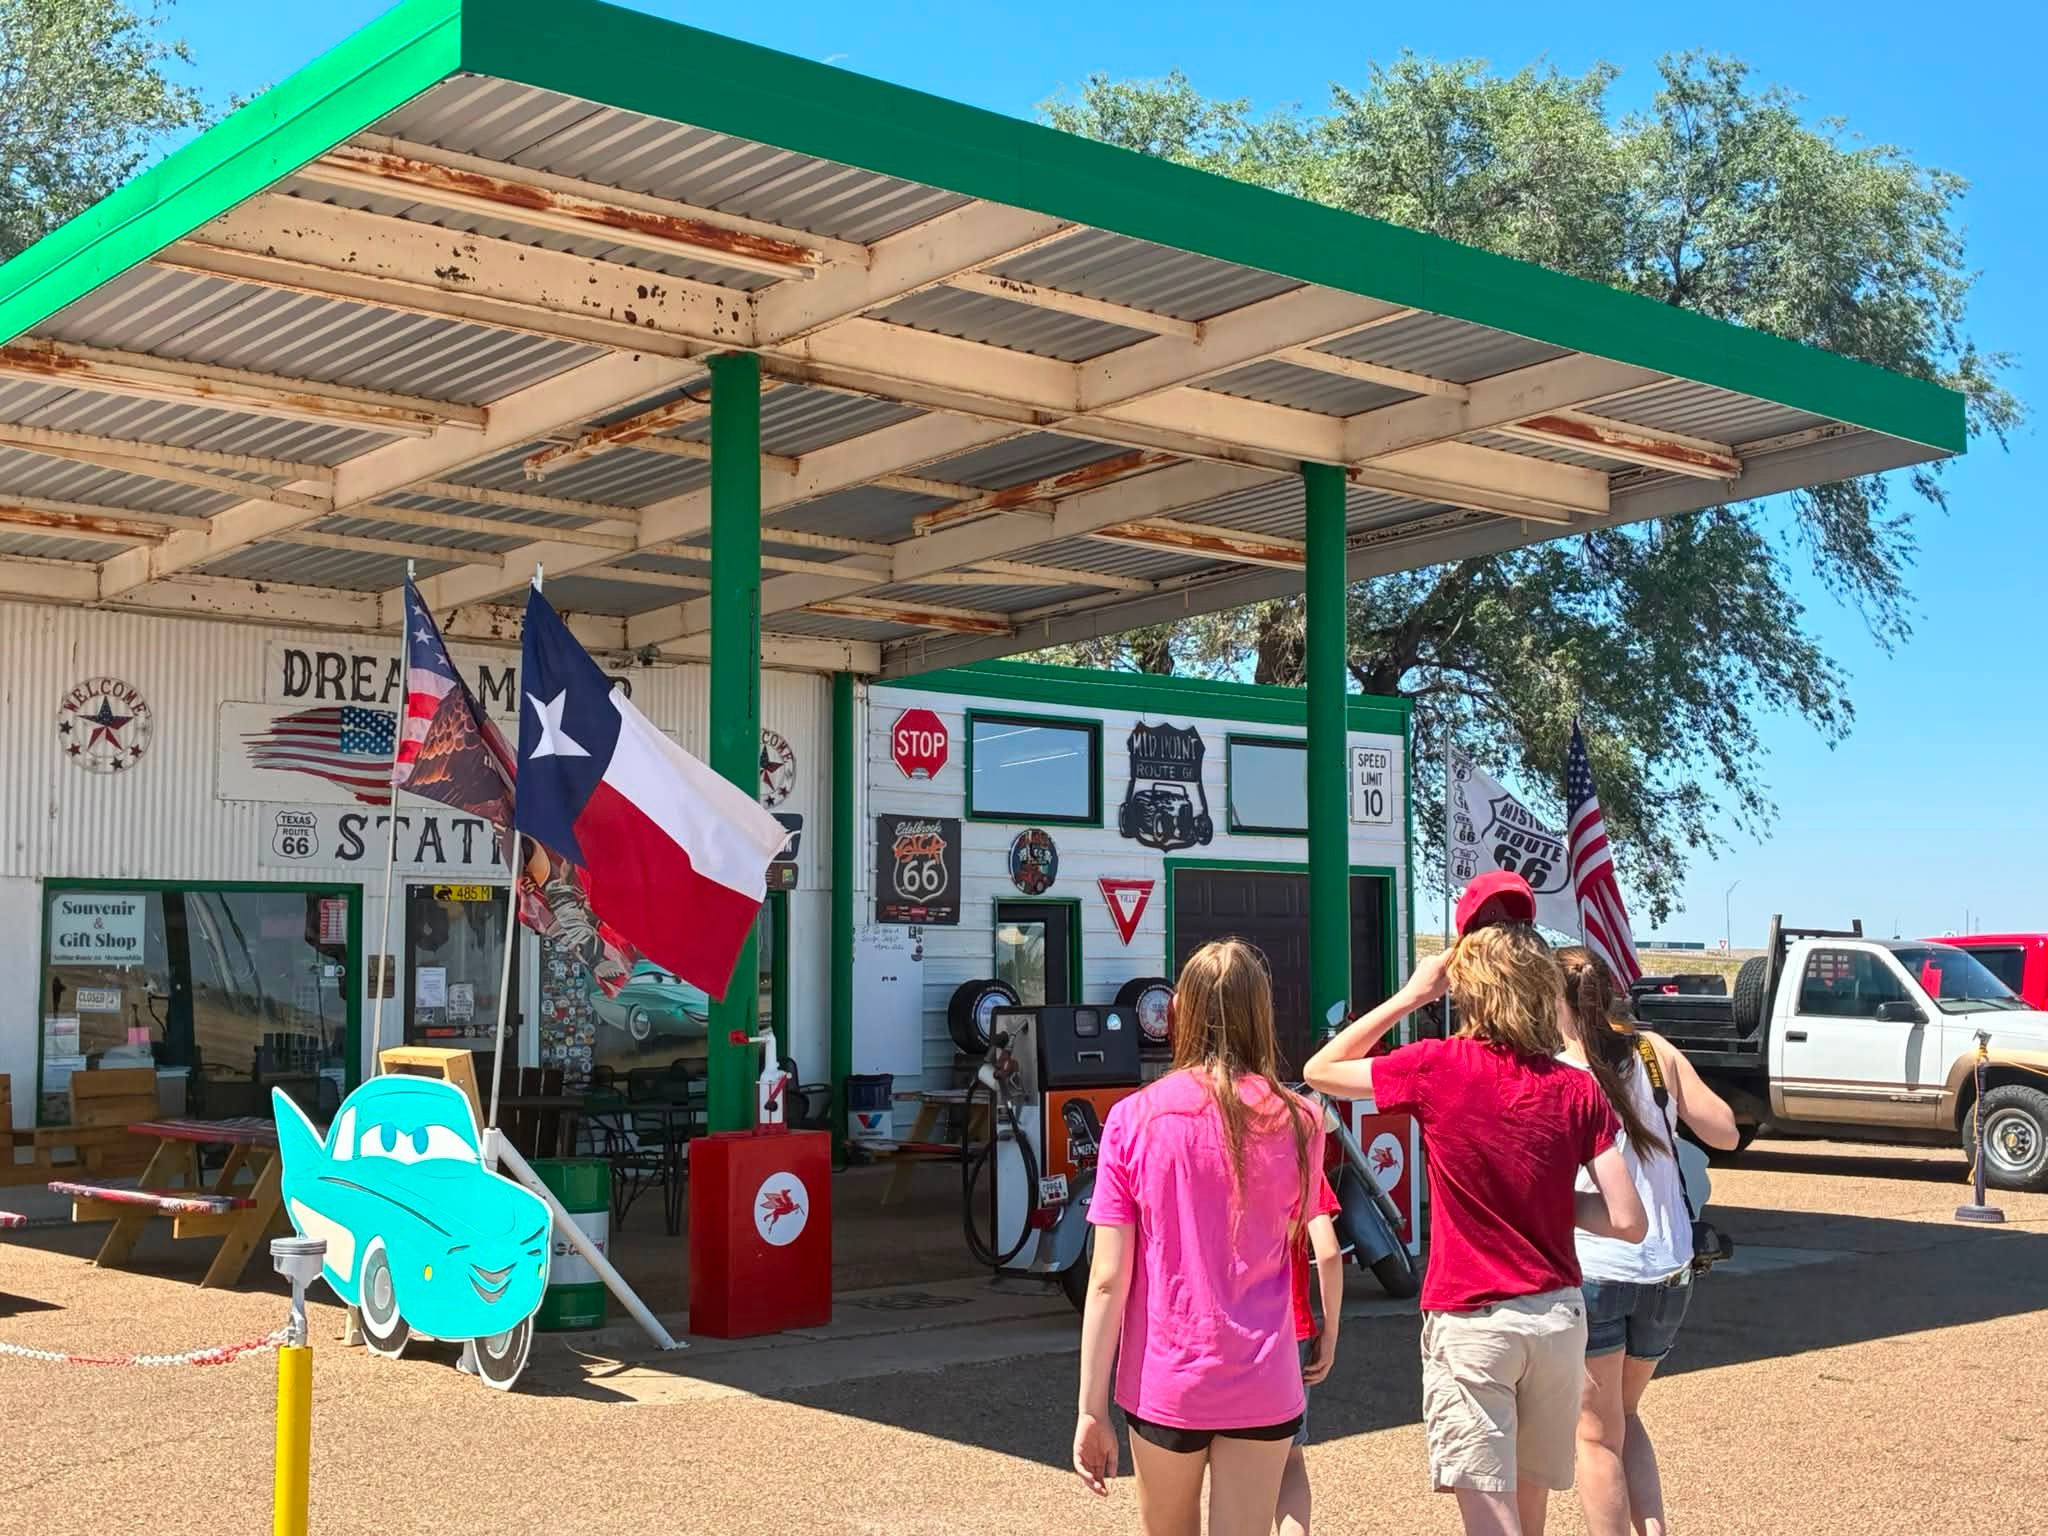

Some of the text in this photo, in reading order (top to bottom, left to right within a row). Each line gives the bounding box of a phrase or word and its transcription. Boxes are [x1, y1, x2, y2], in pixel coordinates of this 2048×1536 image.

[283, 648, 409, 704] DREA
[63, 679, 147, 717] WELCOME
[897, 729, 945, 758] STOP
[1160, 735, 1199, 760] POINT
[1358, 753, 1386, 769] SPEED
[1136, 763, 1176, 779] ROUTE
[1361, 771, 1383, 786] LIMIT
[1363, 789, 1383, 817] 10
[281, 815, 311, 825] TEXAS
[895, 821, 943, 835] Edelbrock
[282, 828, 310, 837] ROUTE
[1459, 831, 1476, 843] 66
[282, 836, 309, 855] 66
[1495, 825, 1563, 863] ROUTE
[1456, 864, 1472, 878] 66
[1494, 843, 1553, 889] 66
[903, 860, 939, 891] 66
[456, 887, 490, 900] 485 M
[62, 901, 136, 916] Souvenir
[93, 916, 104, 930] &
[60, 932, 137, 952] Gift Shop
[78, 992, 105, 1002] CLOSED
